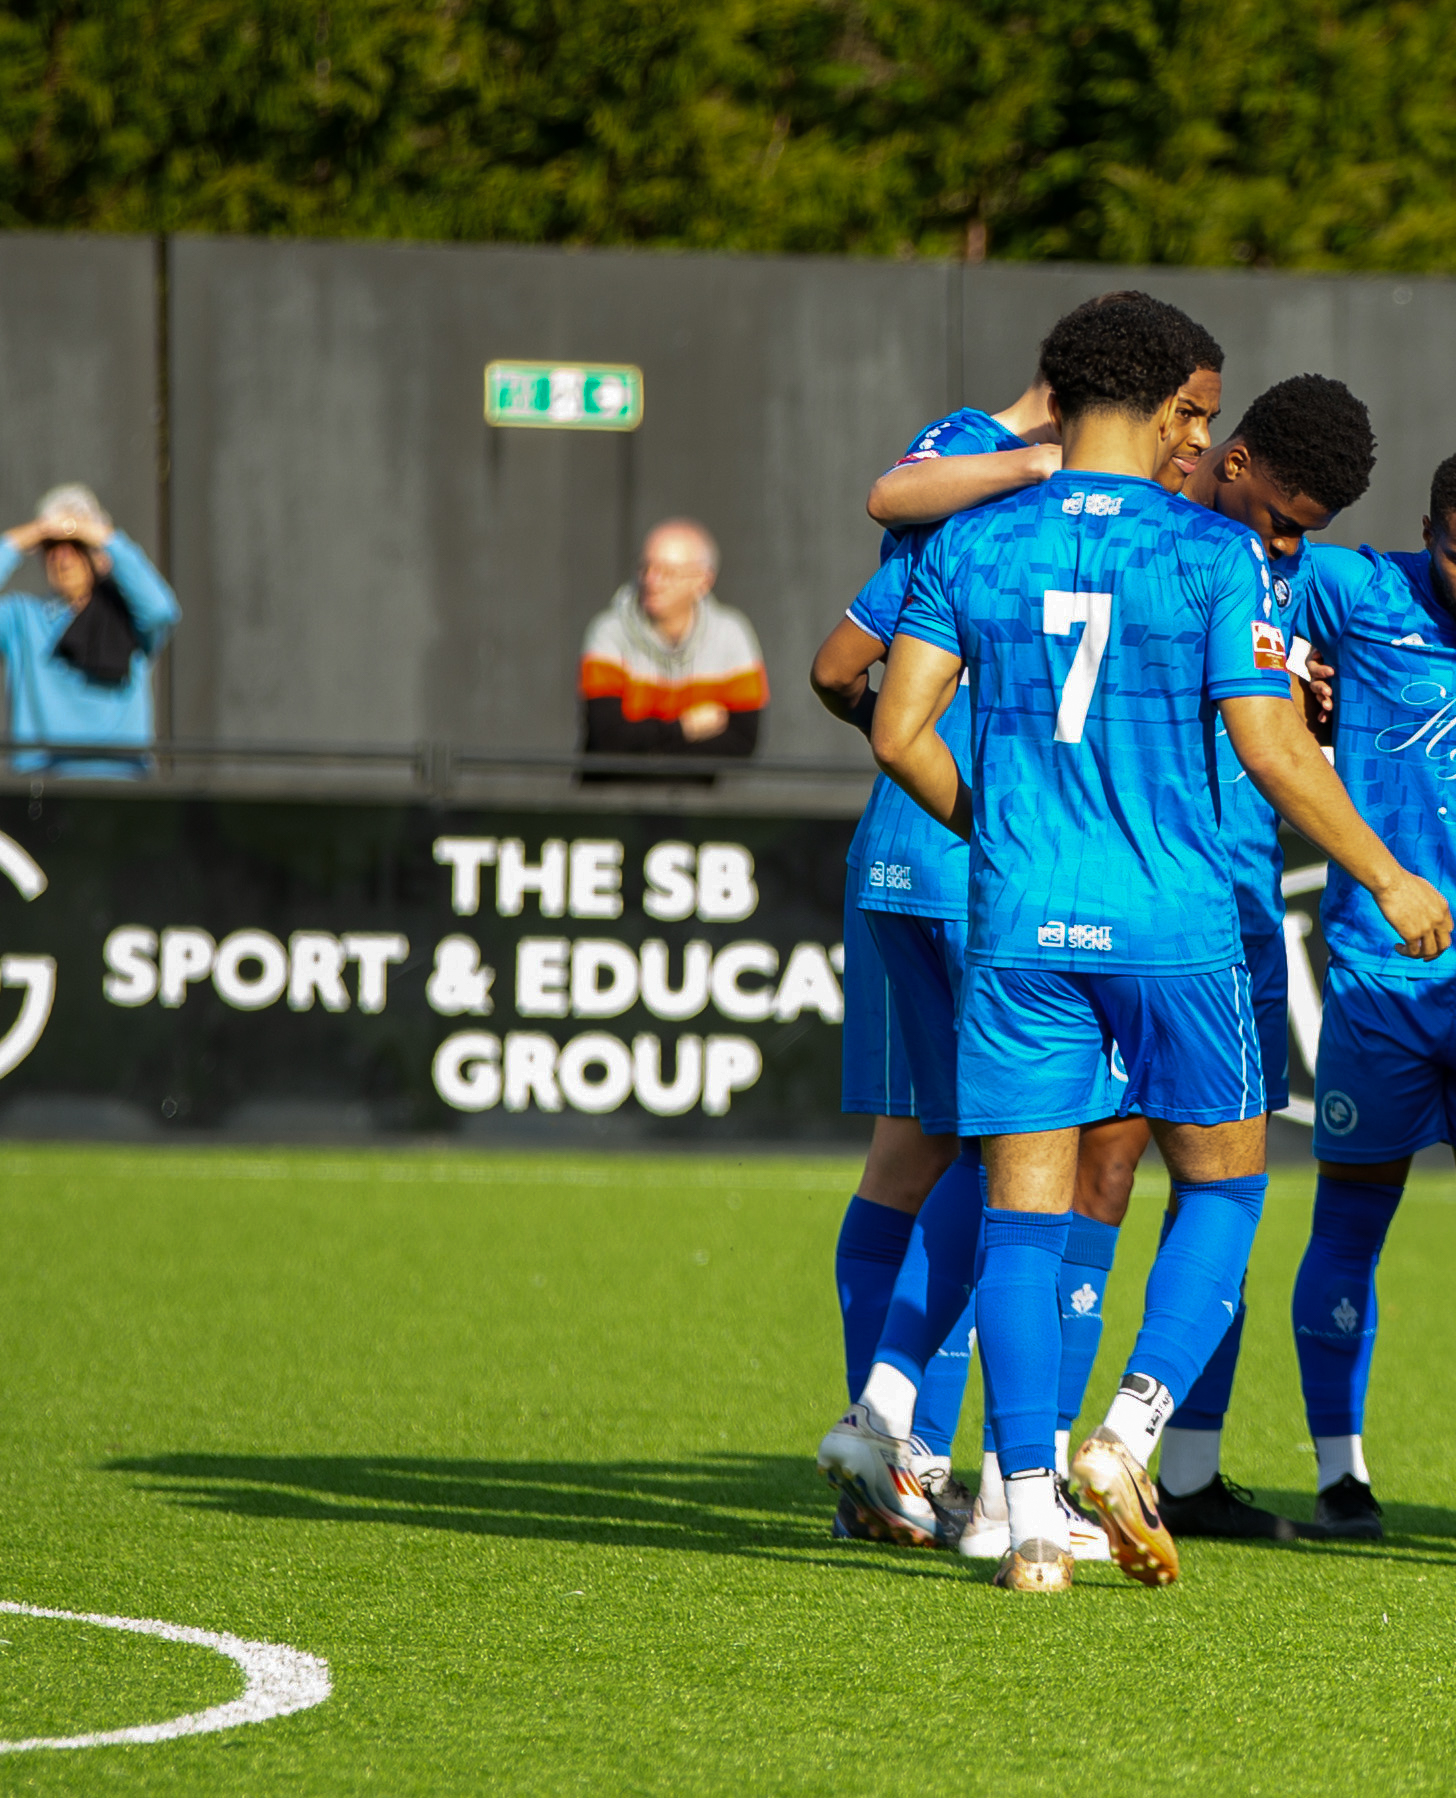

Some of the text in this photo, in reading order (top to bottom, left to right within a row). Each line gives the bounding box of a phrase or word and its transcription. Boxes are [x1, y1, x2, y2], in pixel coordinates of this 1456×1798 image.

[1043, 589, 1113, 743] 7
[433, 838, 758, 922] THE SB
[103, 927, 409, 1013] SPORT
[426, 935, 494, 1015] &
[432, 1031, 762, 1116] GROUP
